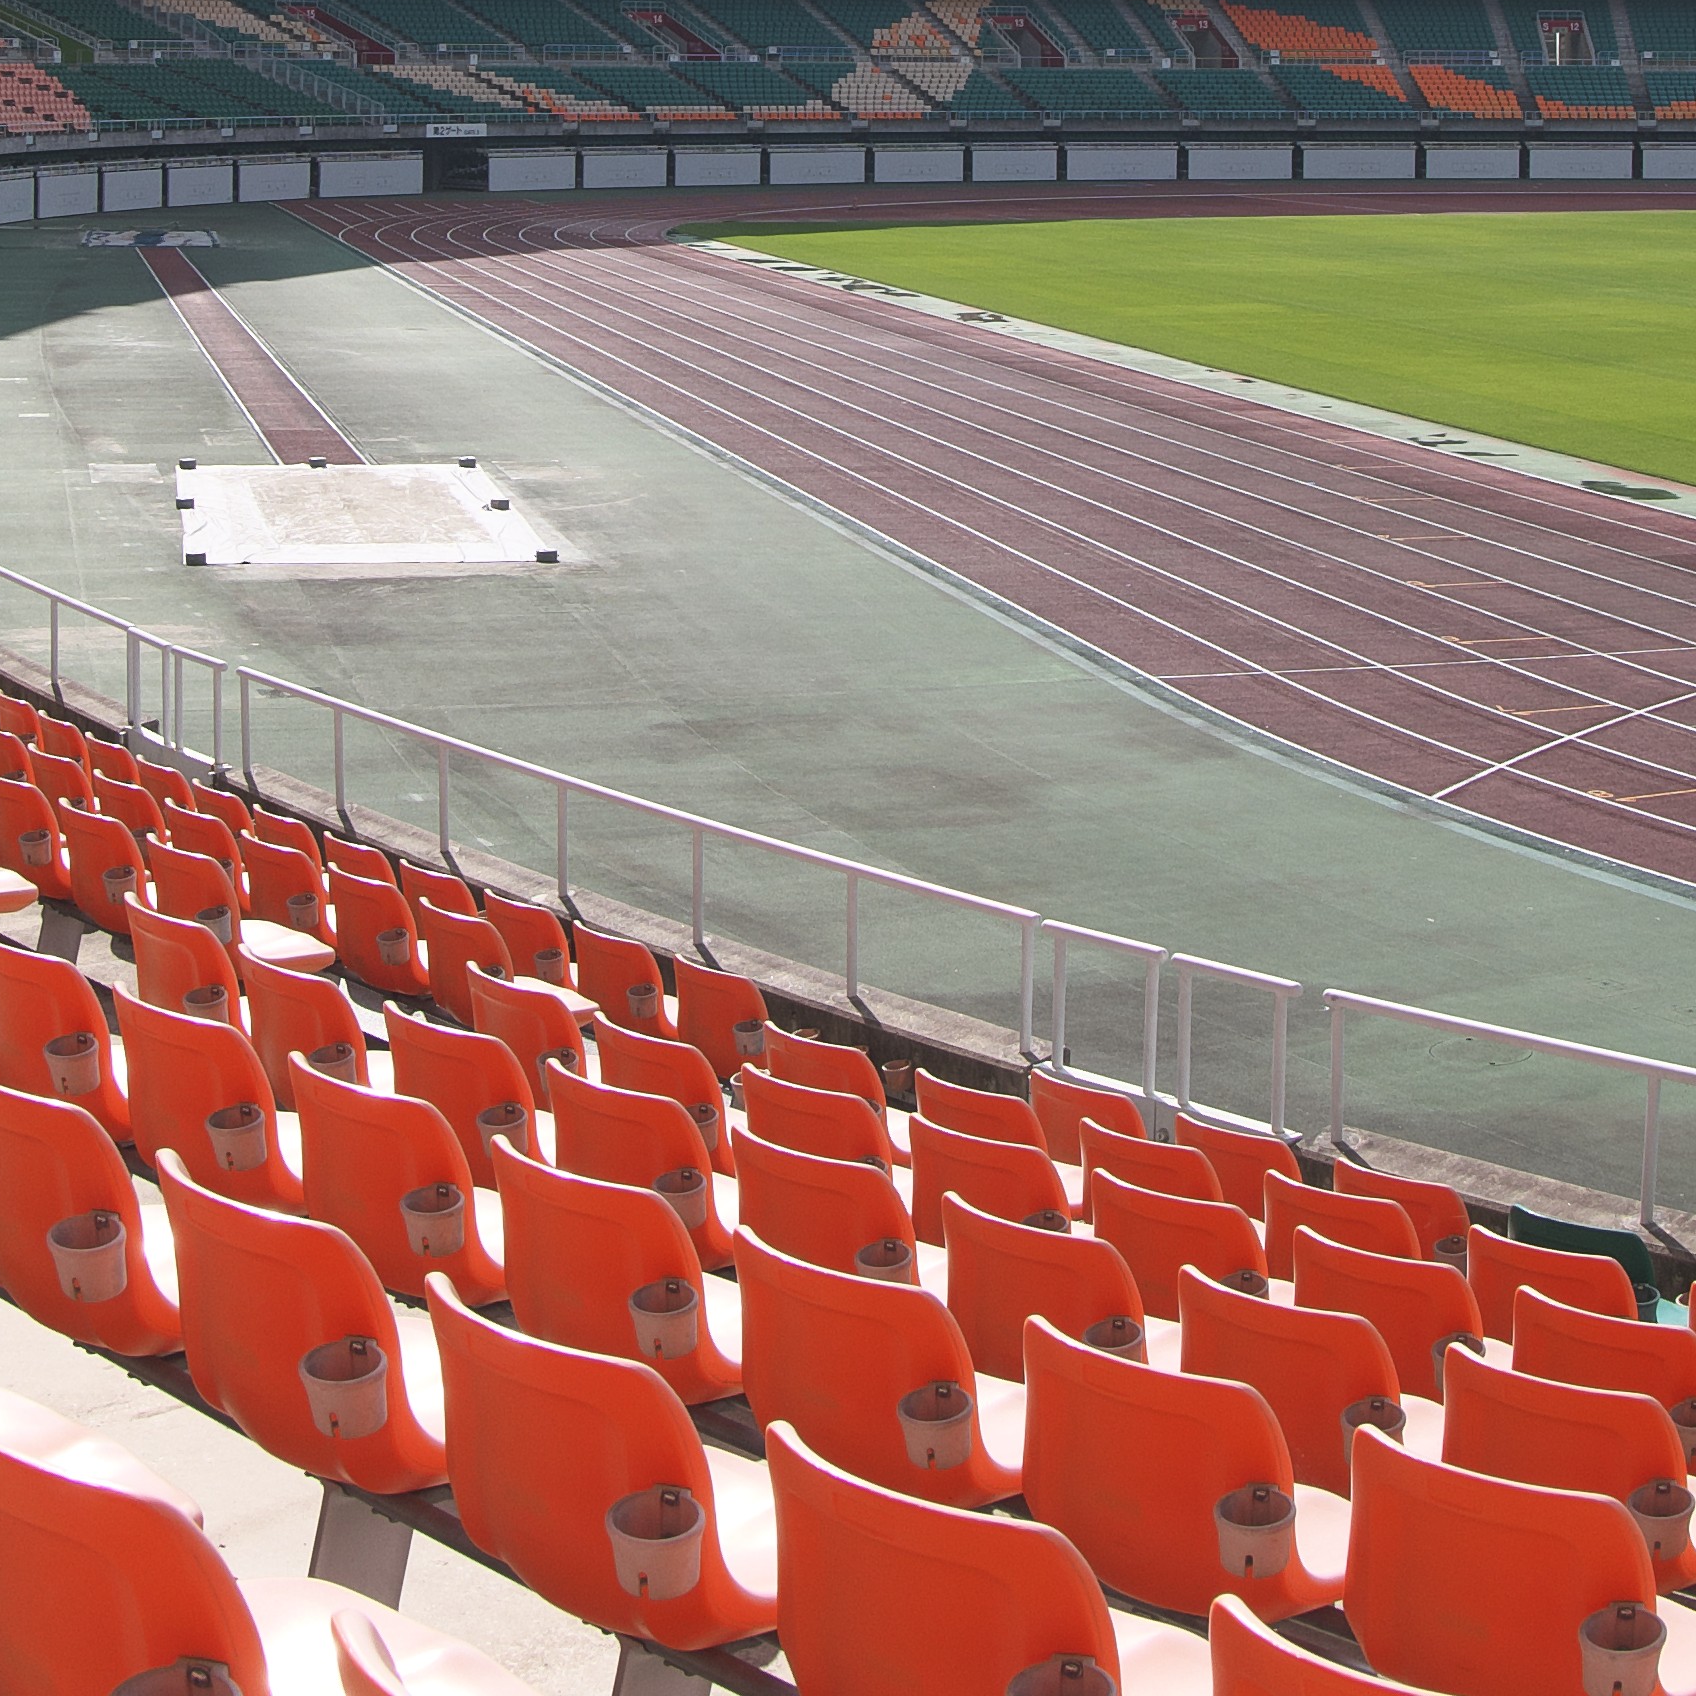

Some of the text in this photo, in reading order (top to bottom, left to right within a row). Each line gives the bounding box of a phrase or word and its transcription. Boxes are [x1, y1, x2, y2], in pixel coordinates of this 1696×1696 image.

[653, 14, 664, 23] 14
[1014, 18, 1024, 28] 13
[1198, 20, 1209, 29] 13
[1542, 22, 1580, 32] S 12
